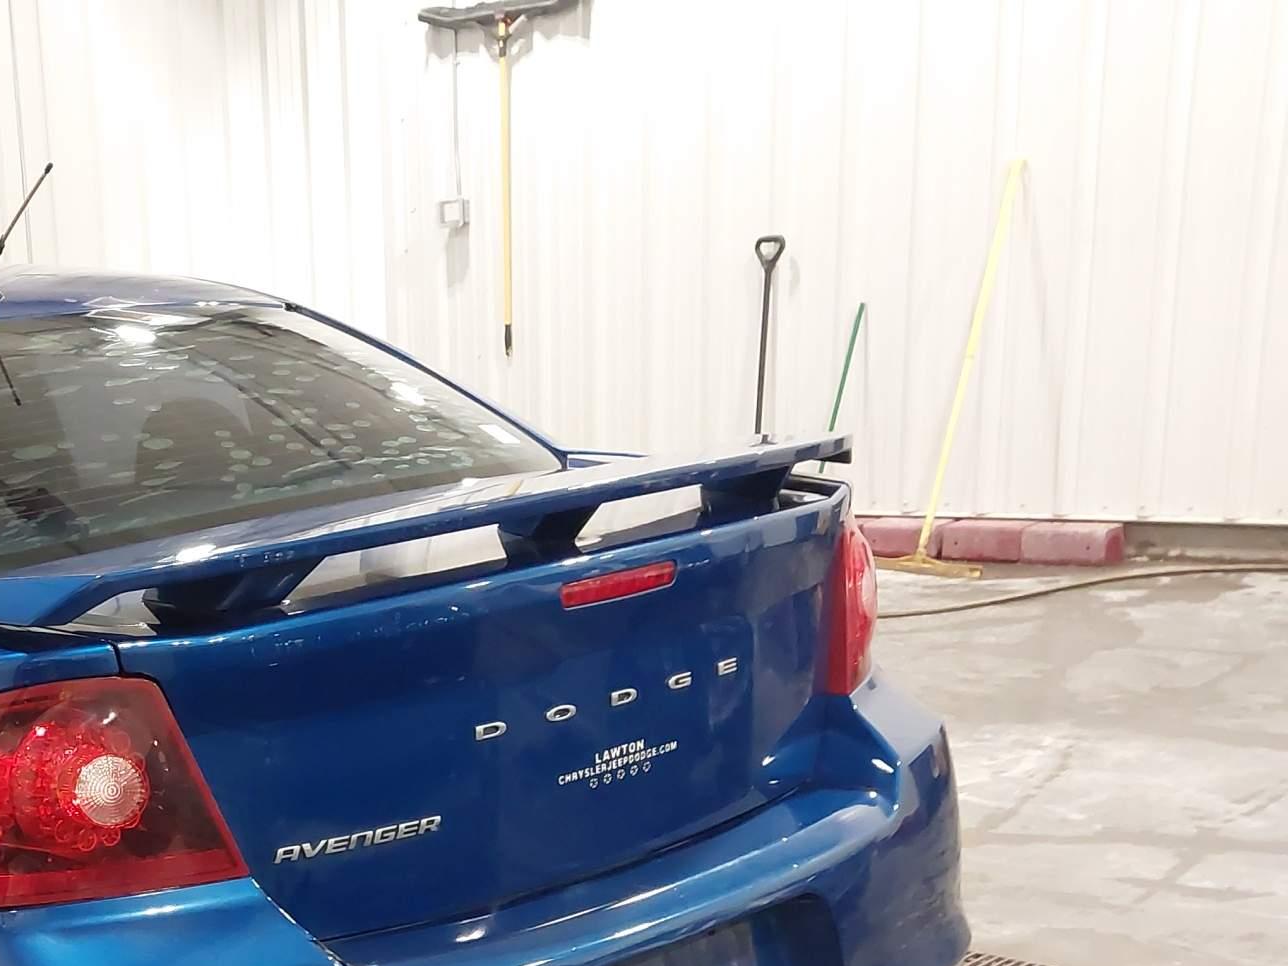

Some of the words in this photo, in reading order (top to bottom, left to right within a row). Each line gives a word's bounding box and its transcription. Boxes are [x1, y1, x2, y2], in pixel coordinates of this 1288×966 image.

[474, 657, 737, 741] DODGE
[558, 740, 678, 786] CHRYSLERJEEPDODGE.COM
[594, 738, 645, 765] LAWTON
[273, 815, 442, 865] AVENGER
